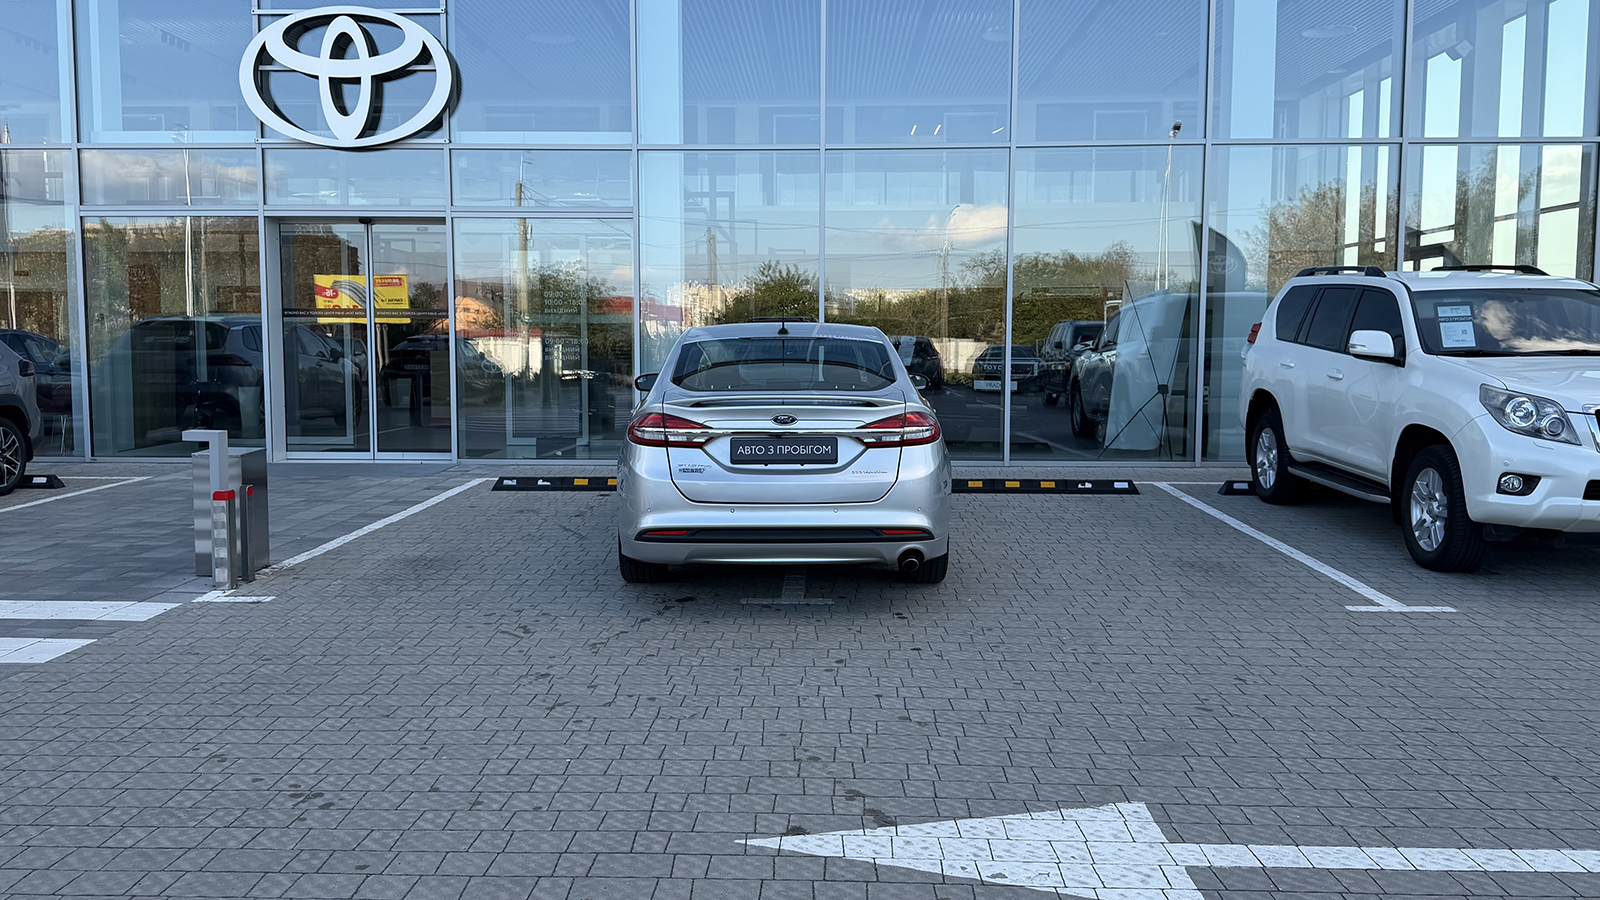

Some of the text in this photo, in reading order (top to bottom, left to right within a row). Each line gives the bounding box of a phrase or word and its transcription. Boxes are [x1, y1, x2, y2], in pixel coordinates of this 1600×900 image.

[544, 306, 578, 314] вихідний
[737, 445, 831, 455] АВТО З ПРОБІГОМ
